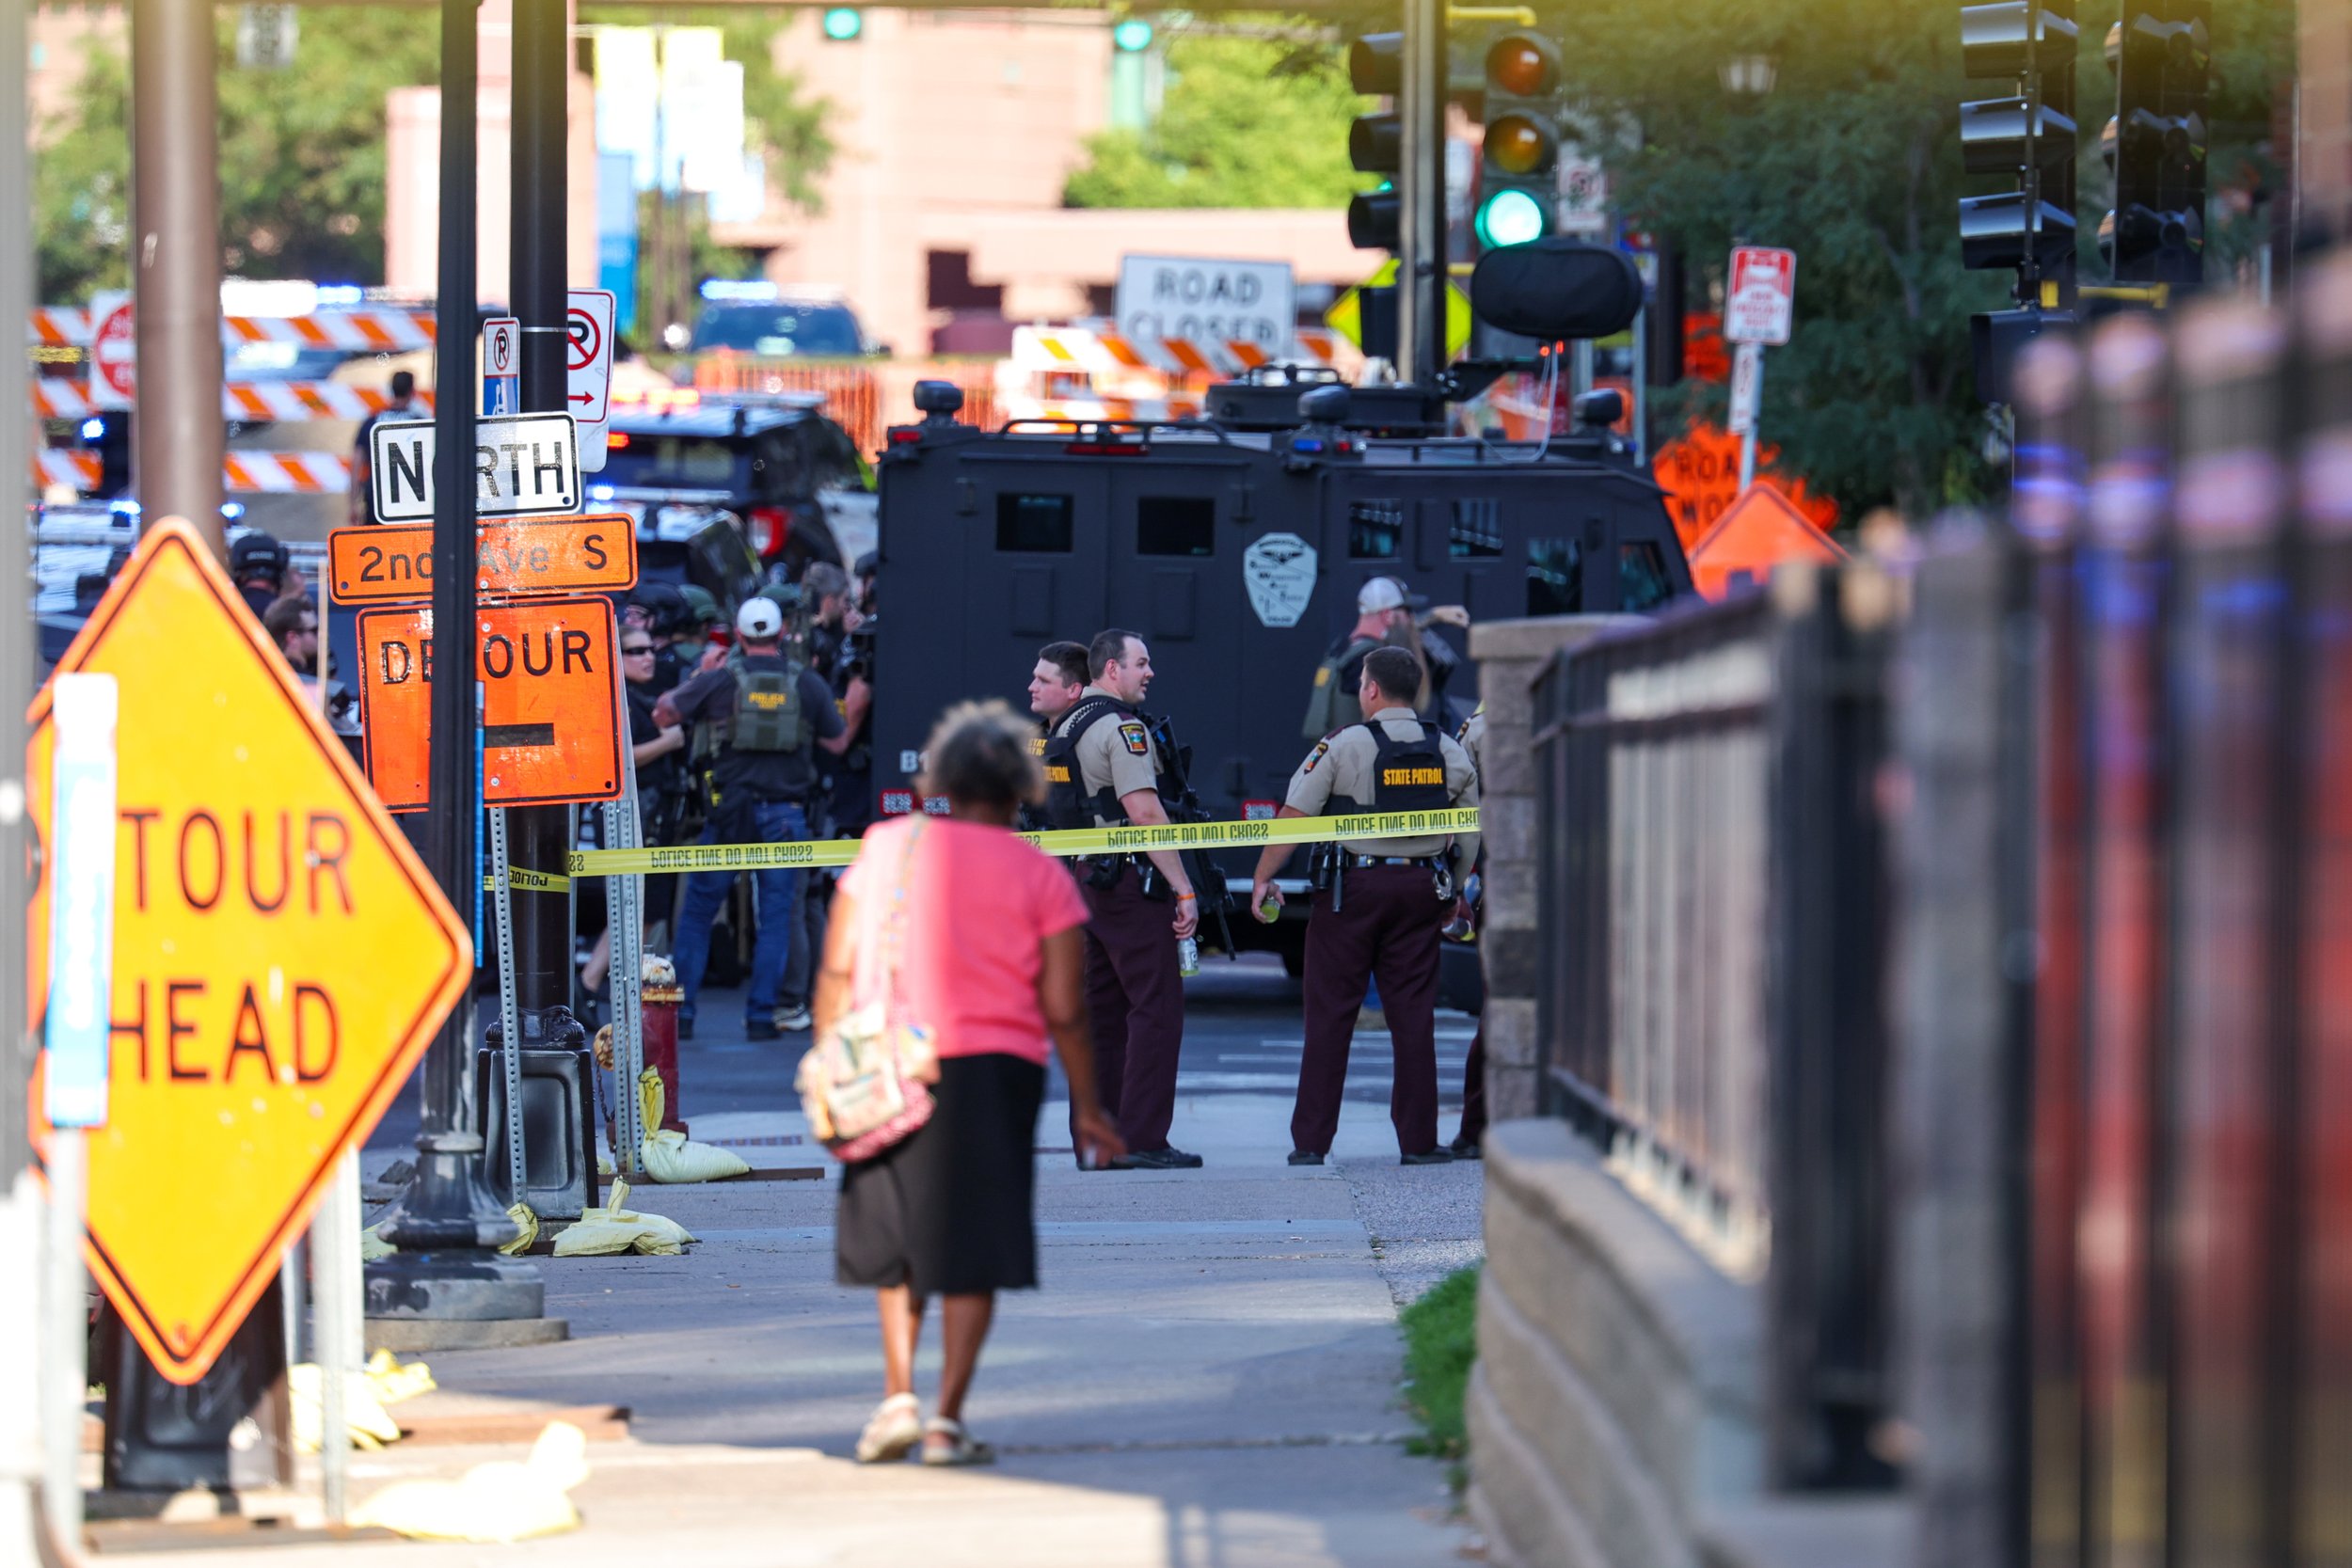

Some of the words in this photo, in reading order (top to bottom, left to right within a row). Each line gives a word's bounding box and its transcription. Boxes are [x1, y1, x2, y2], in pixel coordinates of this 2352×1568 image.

[1153, 267, 1263, 309] ROAD
[388, 440, 564, 503] NRTH
[1677, 451, 1738, 484] ROA
[359, 544, 435, 583] 2nd
[475, 539, 549, 574] Ave
[584, 534, 608, 571] S
[381, 629, 594, 686] DEOUR
[1027, 737, 1048, 749] STAT
[1383, 768, 1410, 786] STATE
[1411, 768, 1443, 785] PATROL
[119, 808, 355, 916] TOUR
[107, 979, 341, 1085] HEAD
